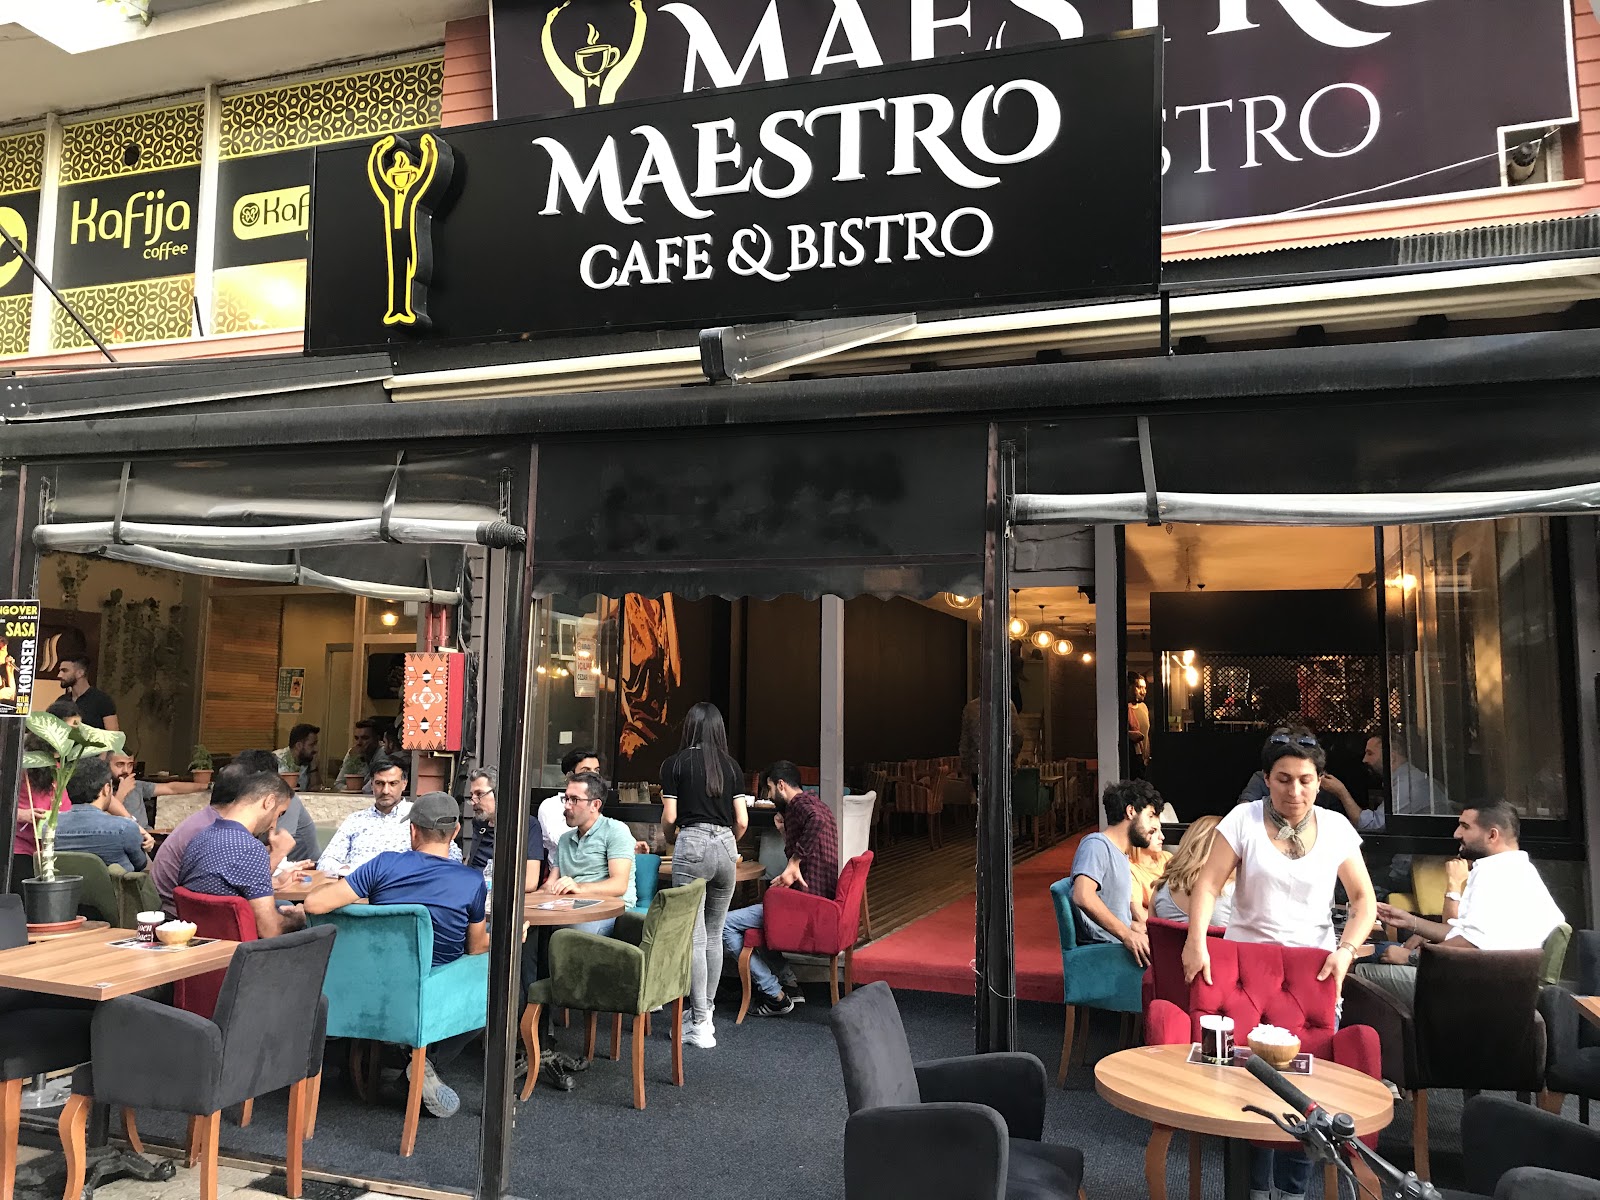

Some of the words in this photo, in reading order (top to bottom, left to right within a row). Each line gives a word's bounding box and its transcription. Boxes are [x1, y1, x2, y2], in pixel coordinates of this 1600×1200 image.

[531, 78, 1062, 225] MAESTRO
[1161, 82, 1381, 176] TRO
[70, 189, 191, 249] Kafija
[579, 232, 716, 290] CAFE
[727, 223, 791, 282] &
[786, 206, 995, 273] BISTRO
[143, 241, 189, 261] coffee
[5, 622, 35, 637] SASA
[18, 639, 35, 693] KONSER
